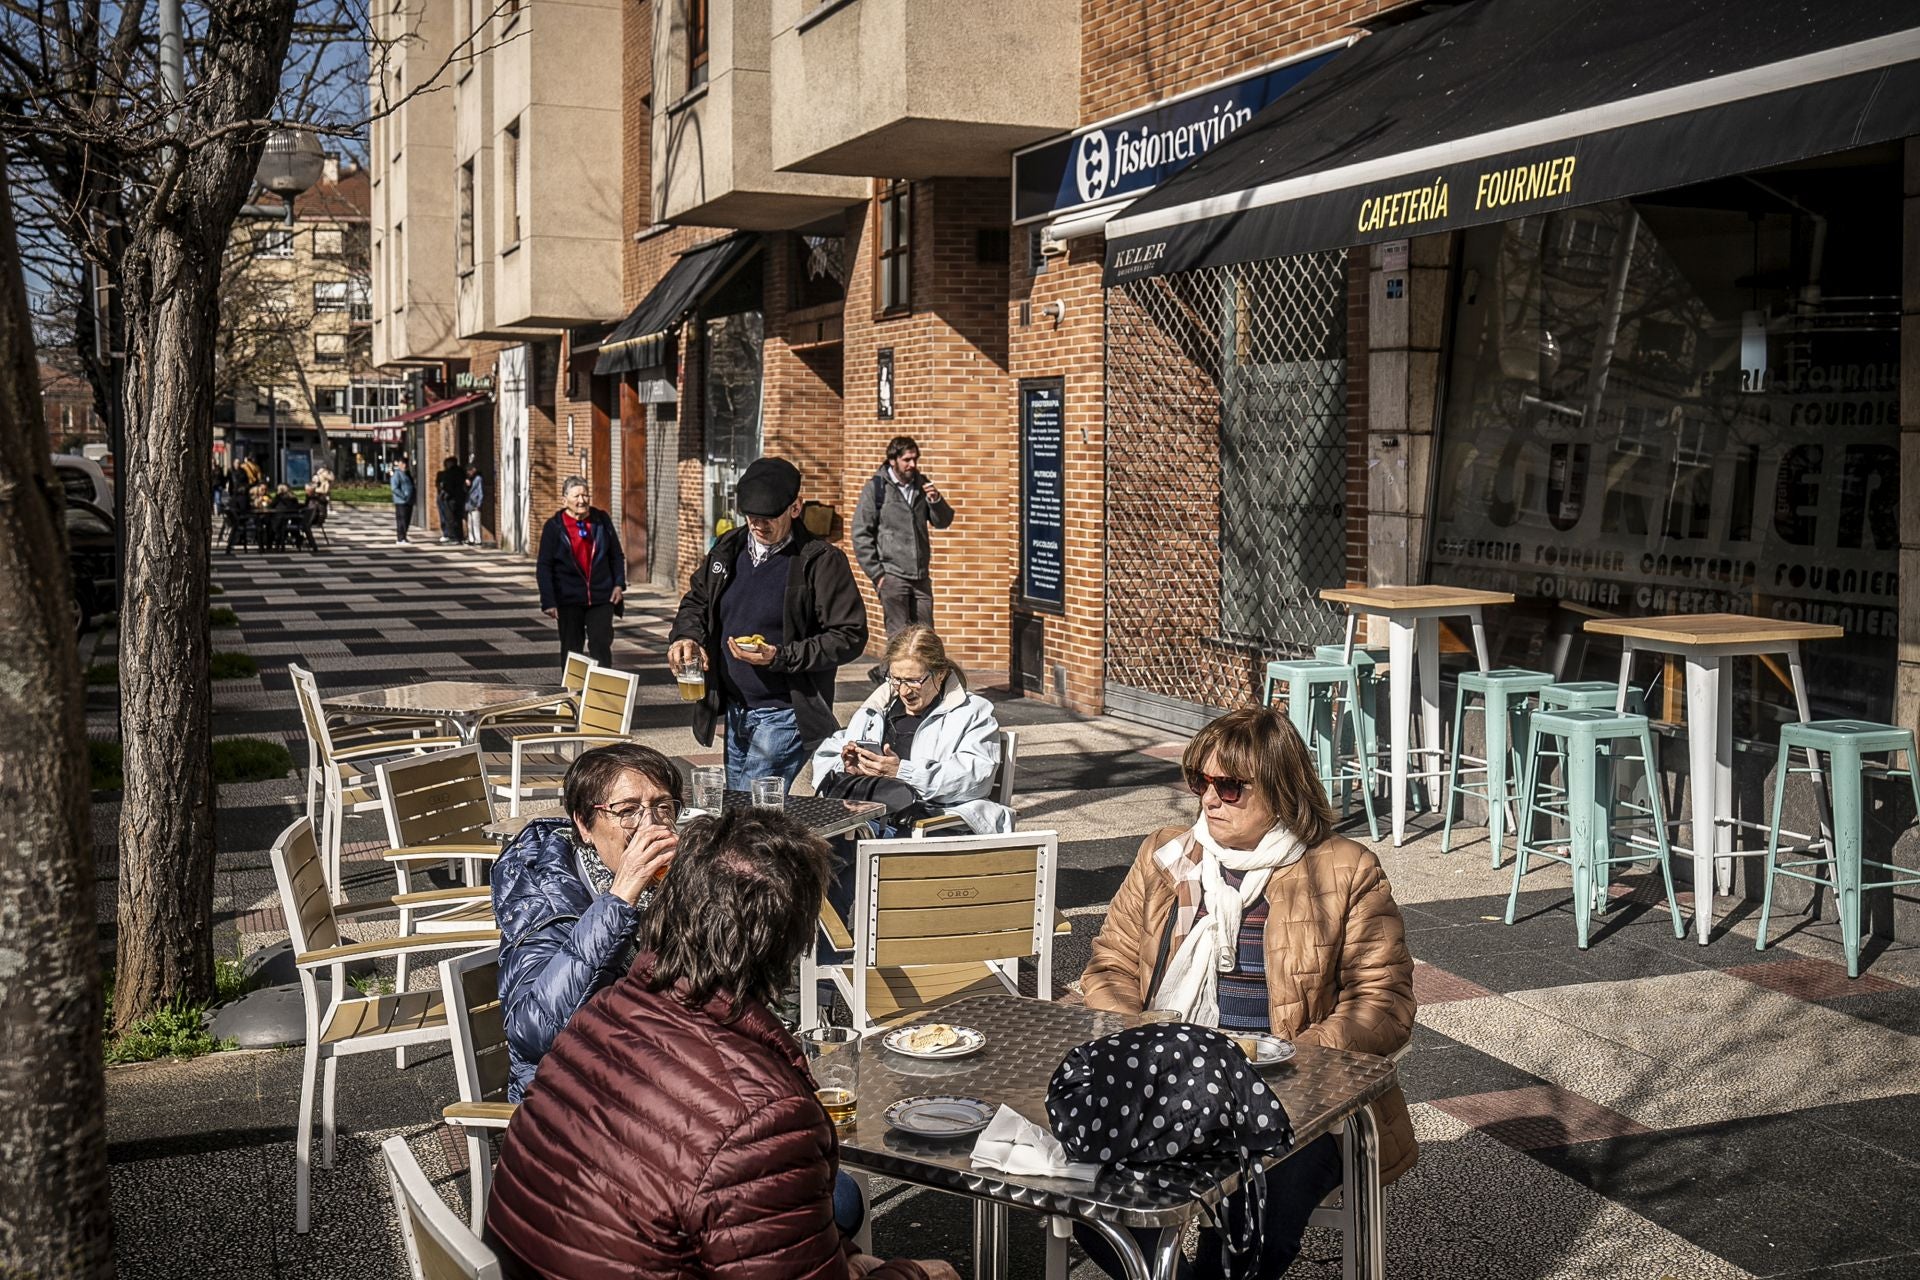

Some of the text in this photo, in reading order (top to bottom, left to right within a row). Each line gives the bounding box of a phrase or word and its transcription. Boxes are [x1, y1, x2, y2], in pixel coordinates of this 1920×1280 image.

[1110, 99, 1253, 189] fisionervión
[1358, 155, 1577, 233] CAFETERÍA FOURNIER
[1113, 242, 1167, 268] KELER
